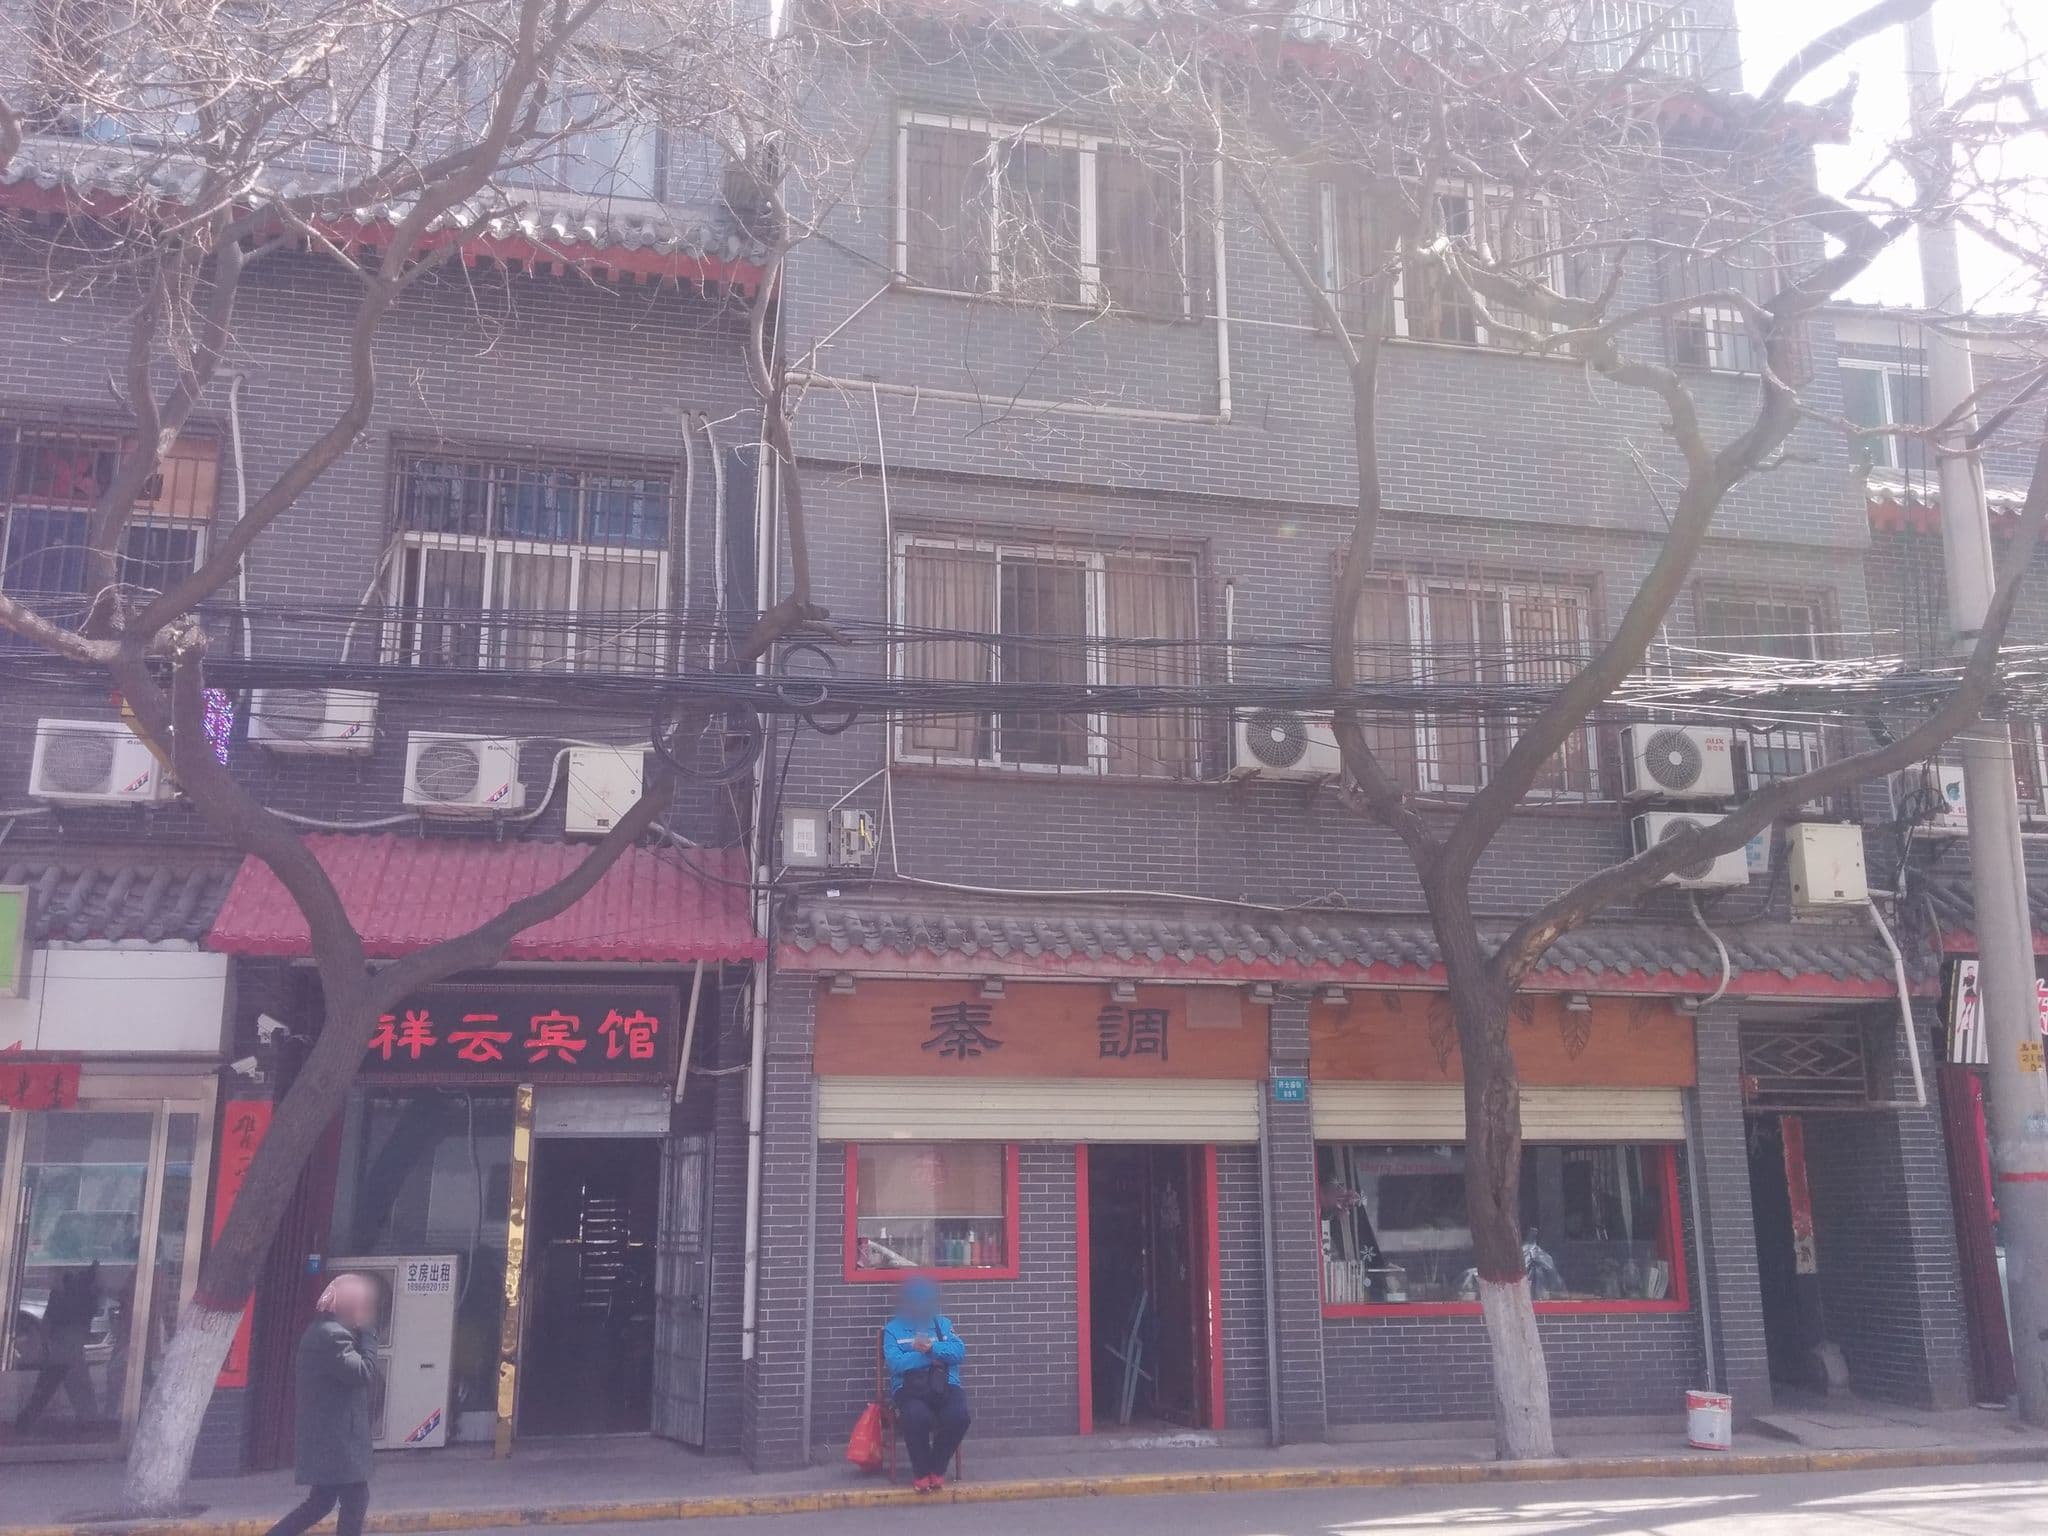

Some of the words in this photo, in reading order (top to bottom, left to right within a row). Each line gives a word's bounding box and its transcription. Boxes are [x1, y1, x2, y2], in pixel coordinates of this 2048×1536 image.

[369, 1009, 659, 1063] 祥云宾馆
[408, 1263, 450, 1282] 空房出租
